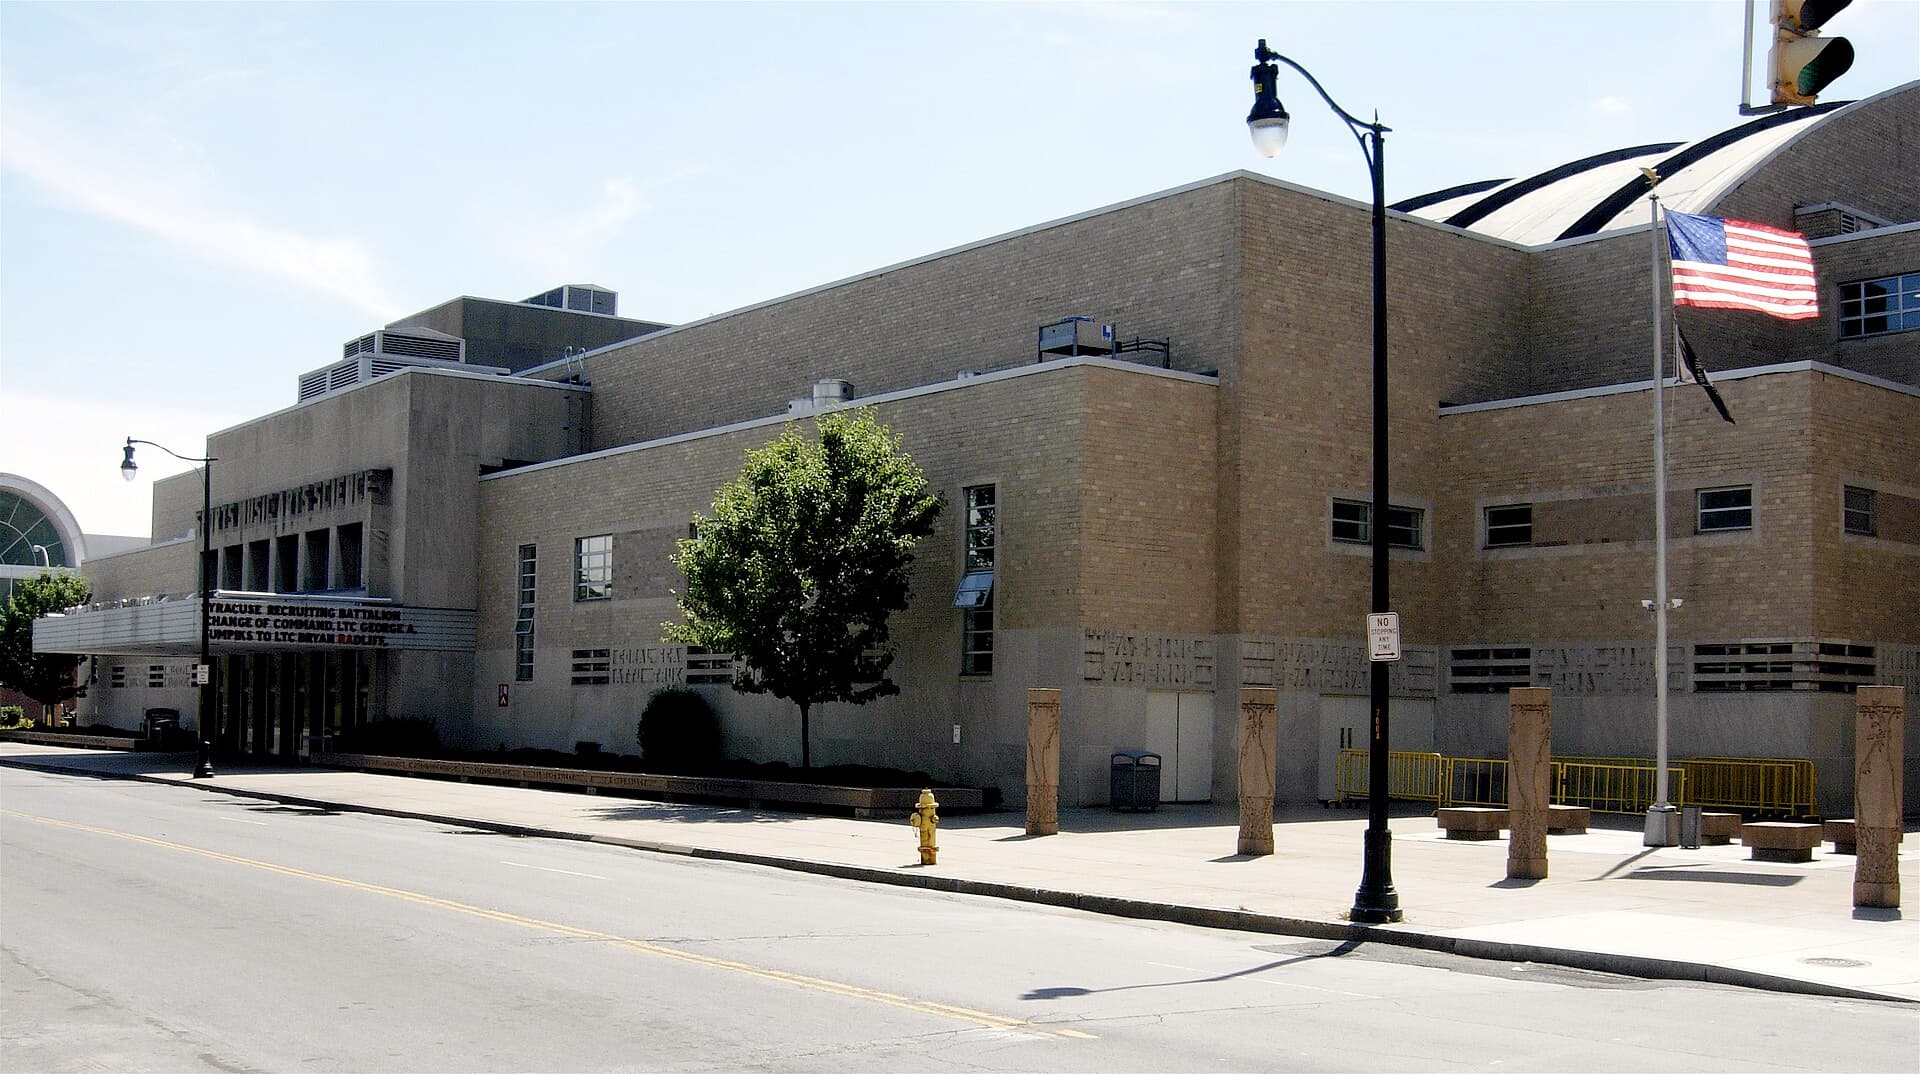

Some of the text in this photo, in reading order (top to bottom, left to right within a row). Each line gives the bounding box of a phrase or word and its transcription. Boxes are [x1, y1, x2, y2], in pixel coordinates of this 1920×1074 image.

[207, 602, 401, 621] YRACUSE RECRUITING BATTALION
[255, 617, 270, 629] OF
[337, 620, 358, 633] LTC
[360, 622, 404, 634] GEORGE
[1377, 617, 1389, 627] NO
[206, 628, 253, 641] UMPIKS
[256, 630, 271, 642] TO
[275, 631, 296, 643] LTC
[298, 632, 335, 644] BRYAN
[1371, 628, 1397, 636] STOPPING
